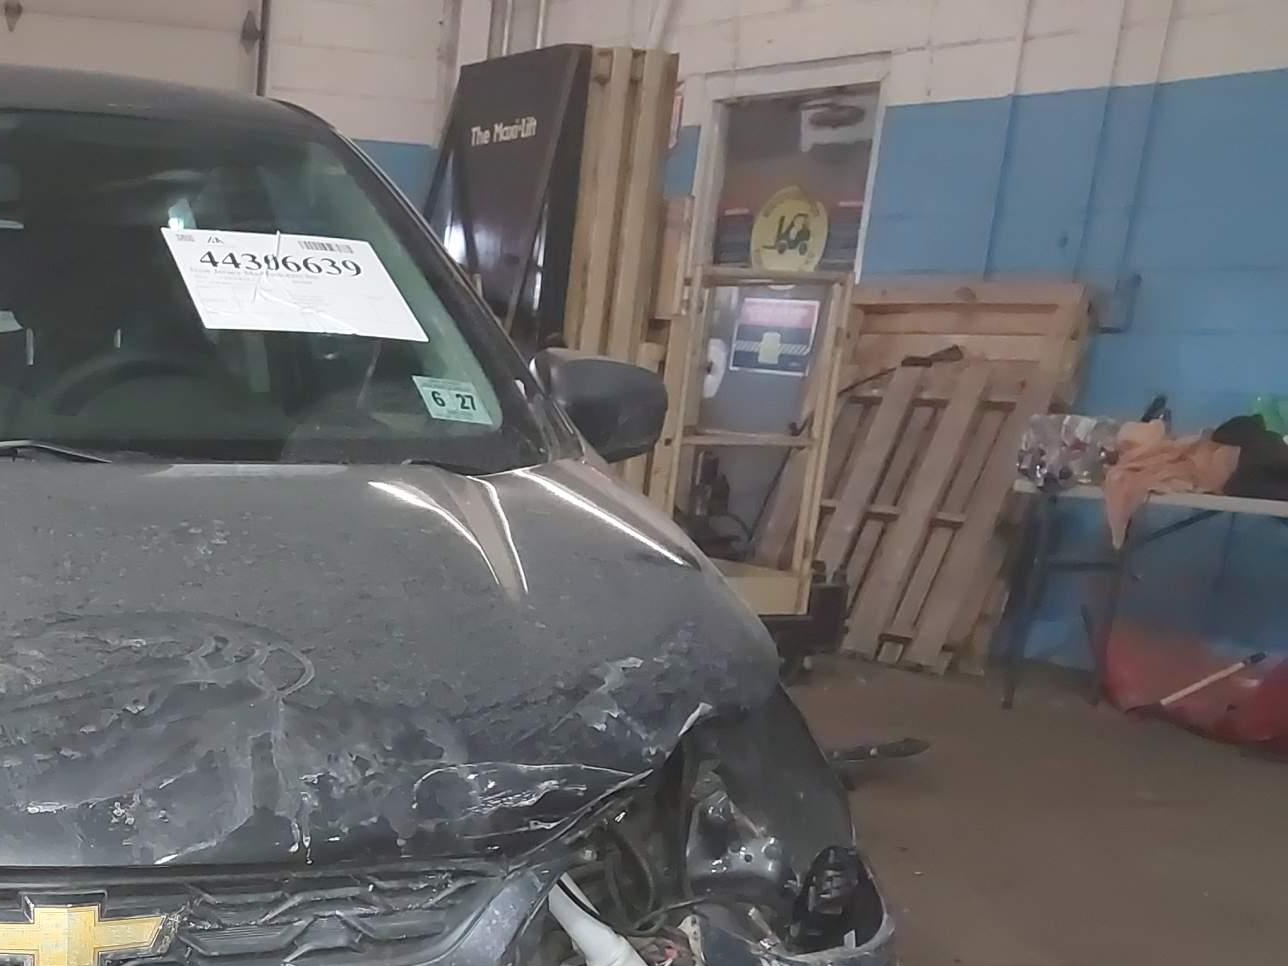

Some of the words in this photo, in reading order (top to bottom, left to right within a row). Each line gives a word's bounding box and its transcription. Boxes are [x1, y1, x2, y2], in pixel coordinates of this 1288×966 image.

[471, 126, 490, 147] The
[199, 251, 362, 277] 44306639
[431, 390, 446, 407] 6
[455, 393, 477, 411] 27
